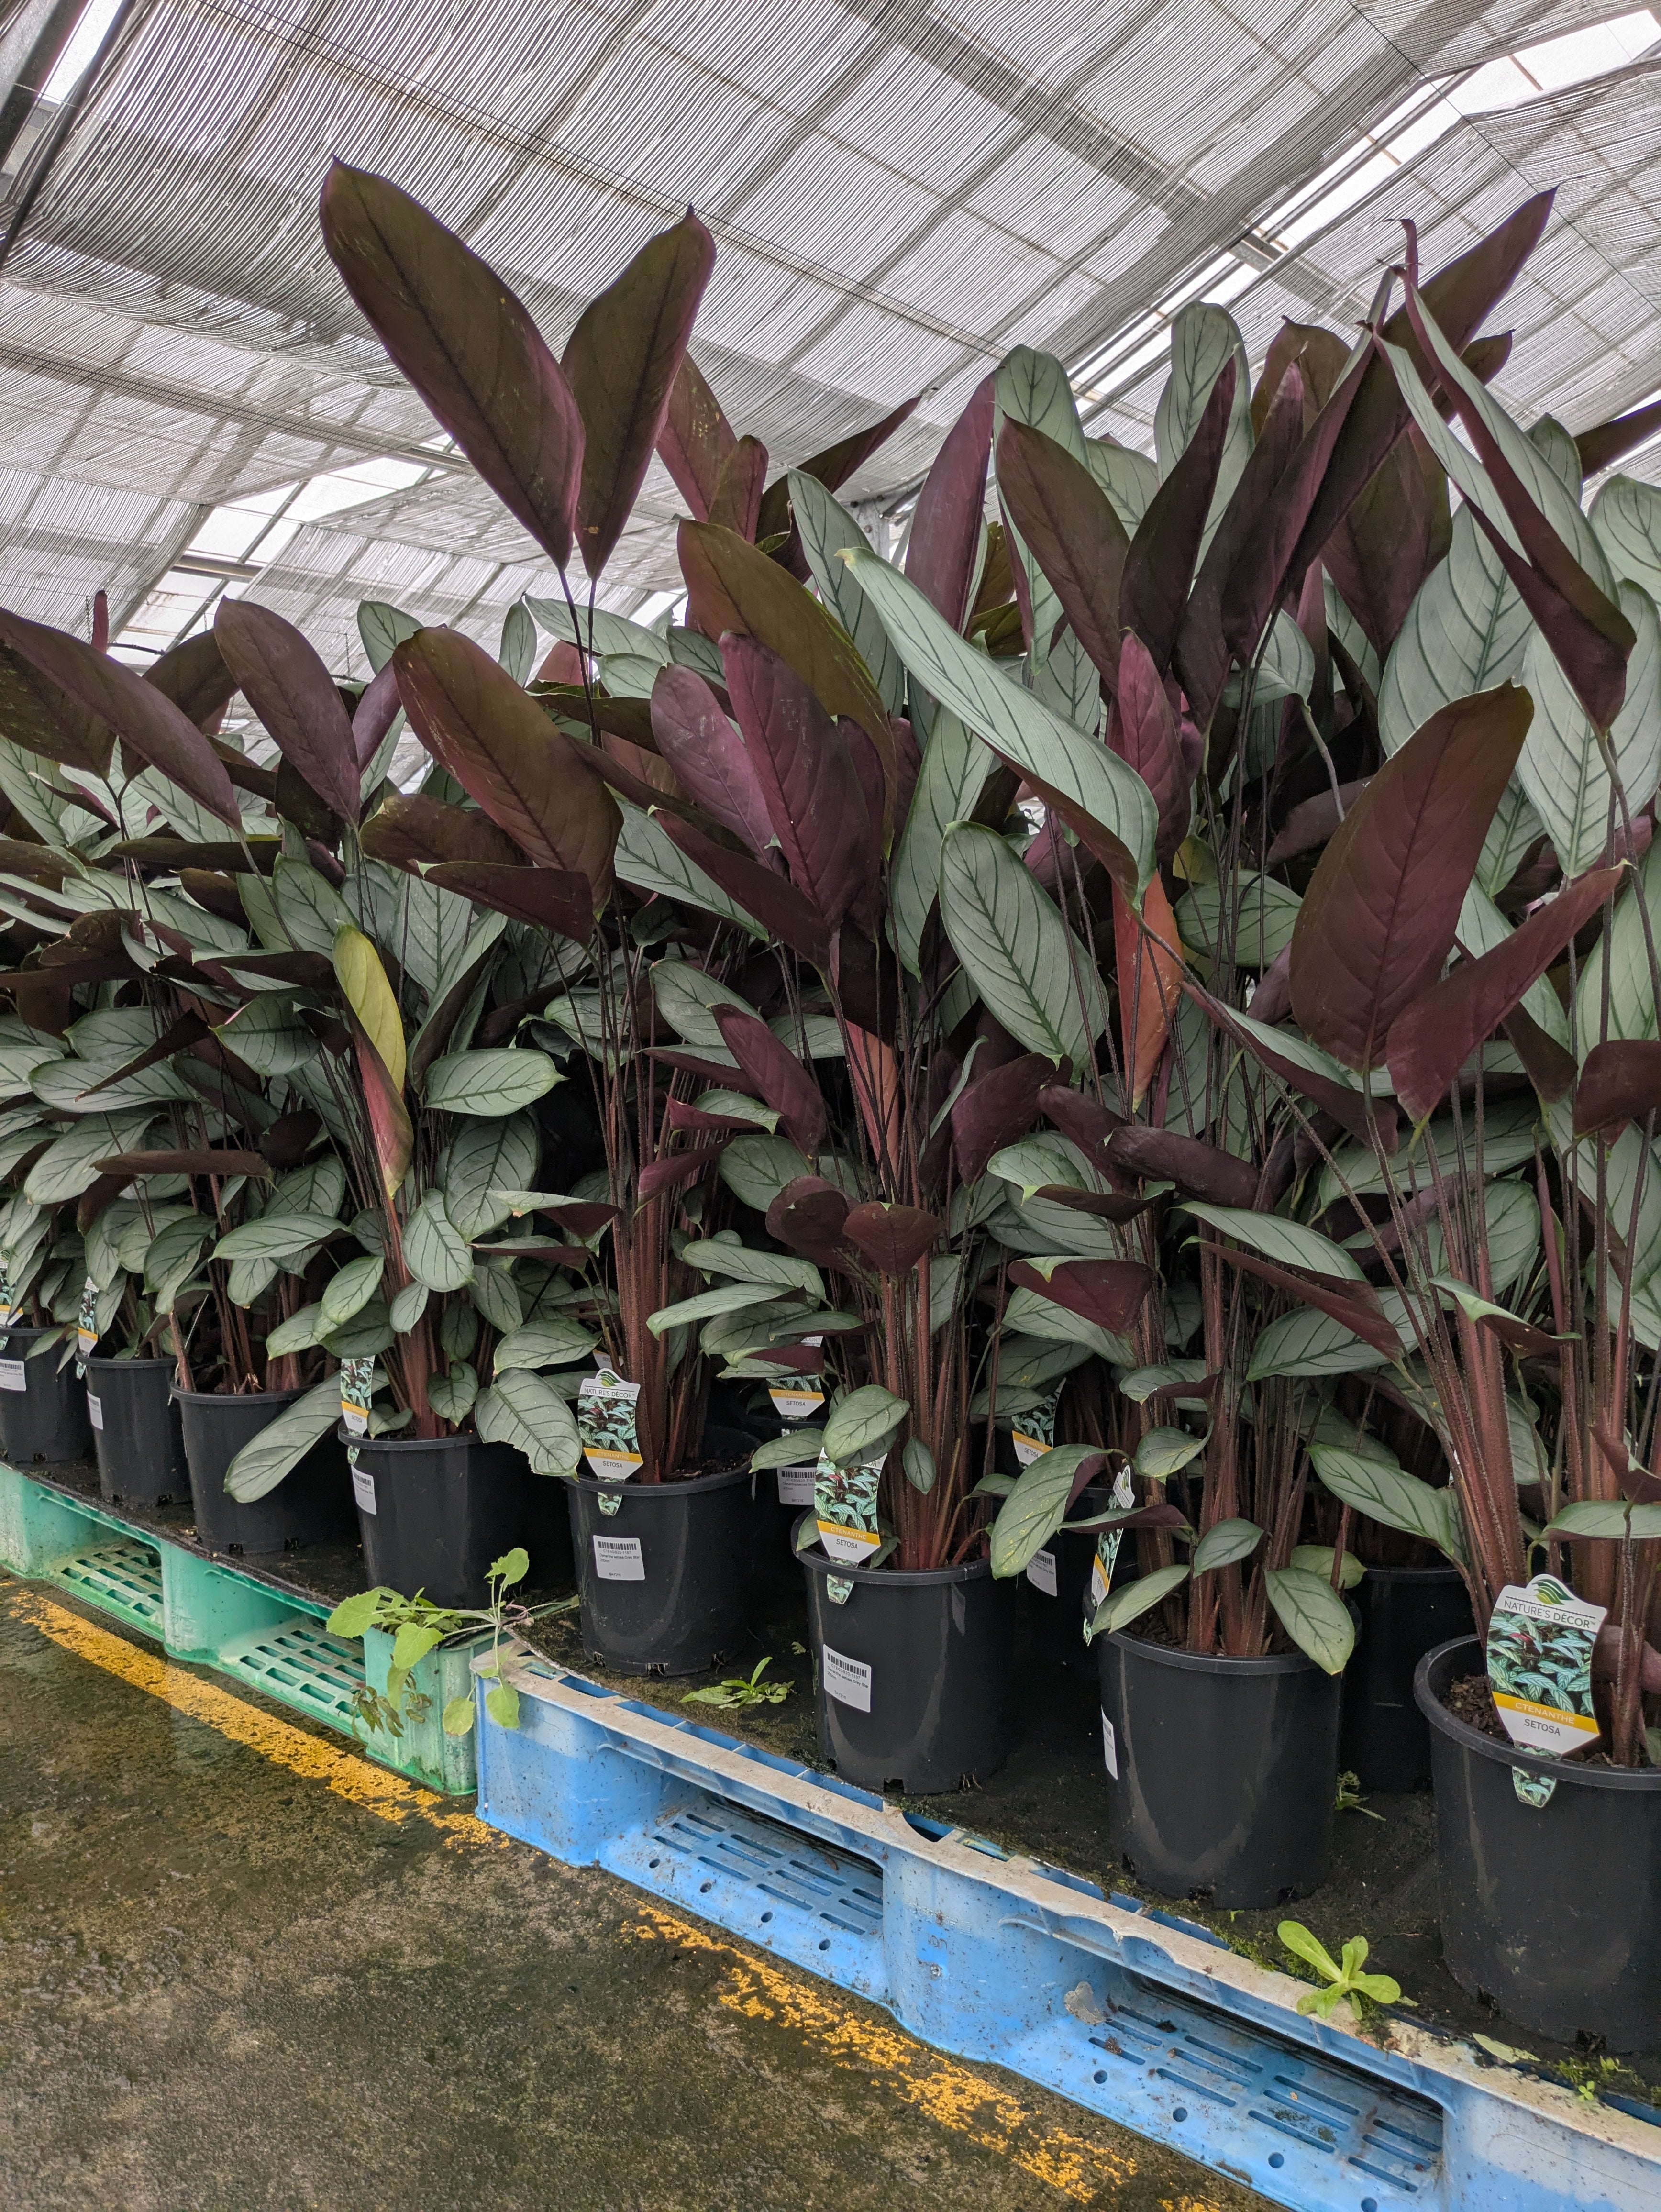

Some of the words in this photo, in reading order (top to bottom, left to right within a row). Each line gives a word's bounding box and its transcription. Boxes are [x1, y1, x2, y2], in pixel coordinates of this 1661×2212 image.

[584, 1388, 610, 1396] NATURE'S
[1024, 1448, 1038, 1458] SETOSA
[830, 1526, 866, 1540] CTENANTHE
[836, 1538, 858, 1549] SETOSA
[1504, 1600, 1550, 1619] NATURE'S
[1515, 1702, 1575, 1724] CTENANTHE
[1524, 1719, 1560, 1736] SETOSA
